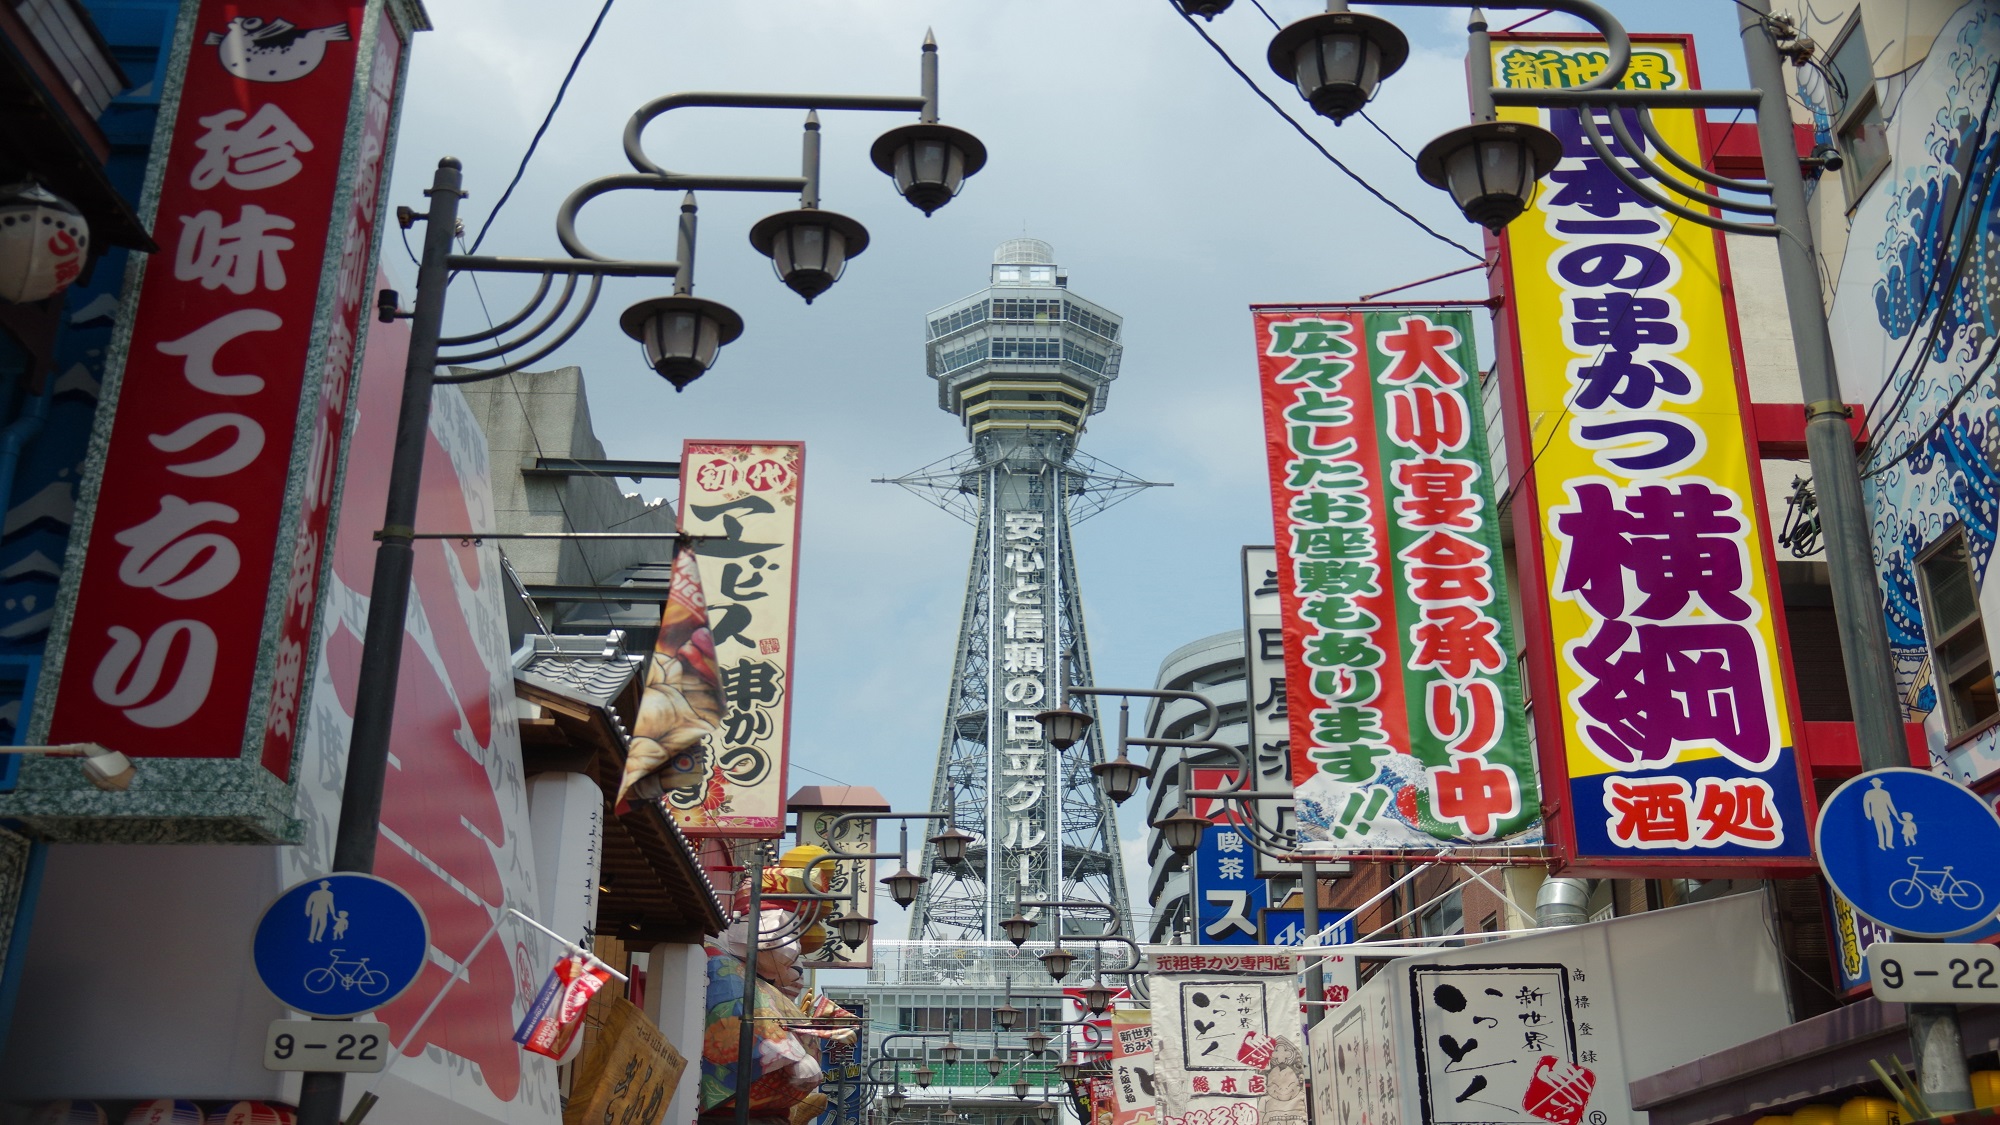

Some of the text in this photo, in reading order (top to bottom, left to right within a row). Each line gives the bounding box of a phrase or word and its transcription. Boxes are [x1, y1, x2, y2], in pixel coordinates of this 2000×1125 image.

[1503, 49, 1675, 89] 新世界
[1547, 107, 1697, 470] 日本一の串かつ
[700, 461, 790, 492] 初代
[689, 495, 785, 648] エビス
[1382, 319, 1514, 836] 大小宴会承り中
[1559, 483, 1773, 767] 横綱
[718, 657, 781, 783] 串かつ
[1003, 511, 1047, 921] 安心と信頼の日立グループ
[1612, 780, 1777, 844] 酒処
[1217, 832, 1244, 880] 喫茶
[1156, 955, 1291, 972] 元祖串カツ専門店
[1274, 921, 1347, 946] Ashi
[1515, 985, 1555, 1053] 新世界
[1572, 967, 1598, 1063] 商標登録
